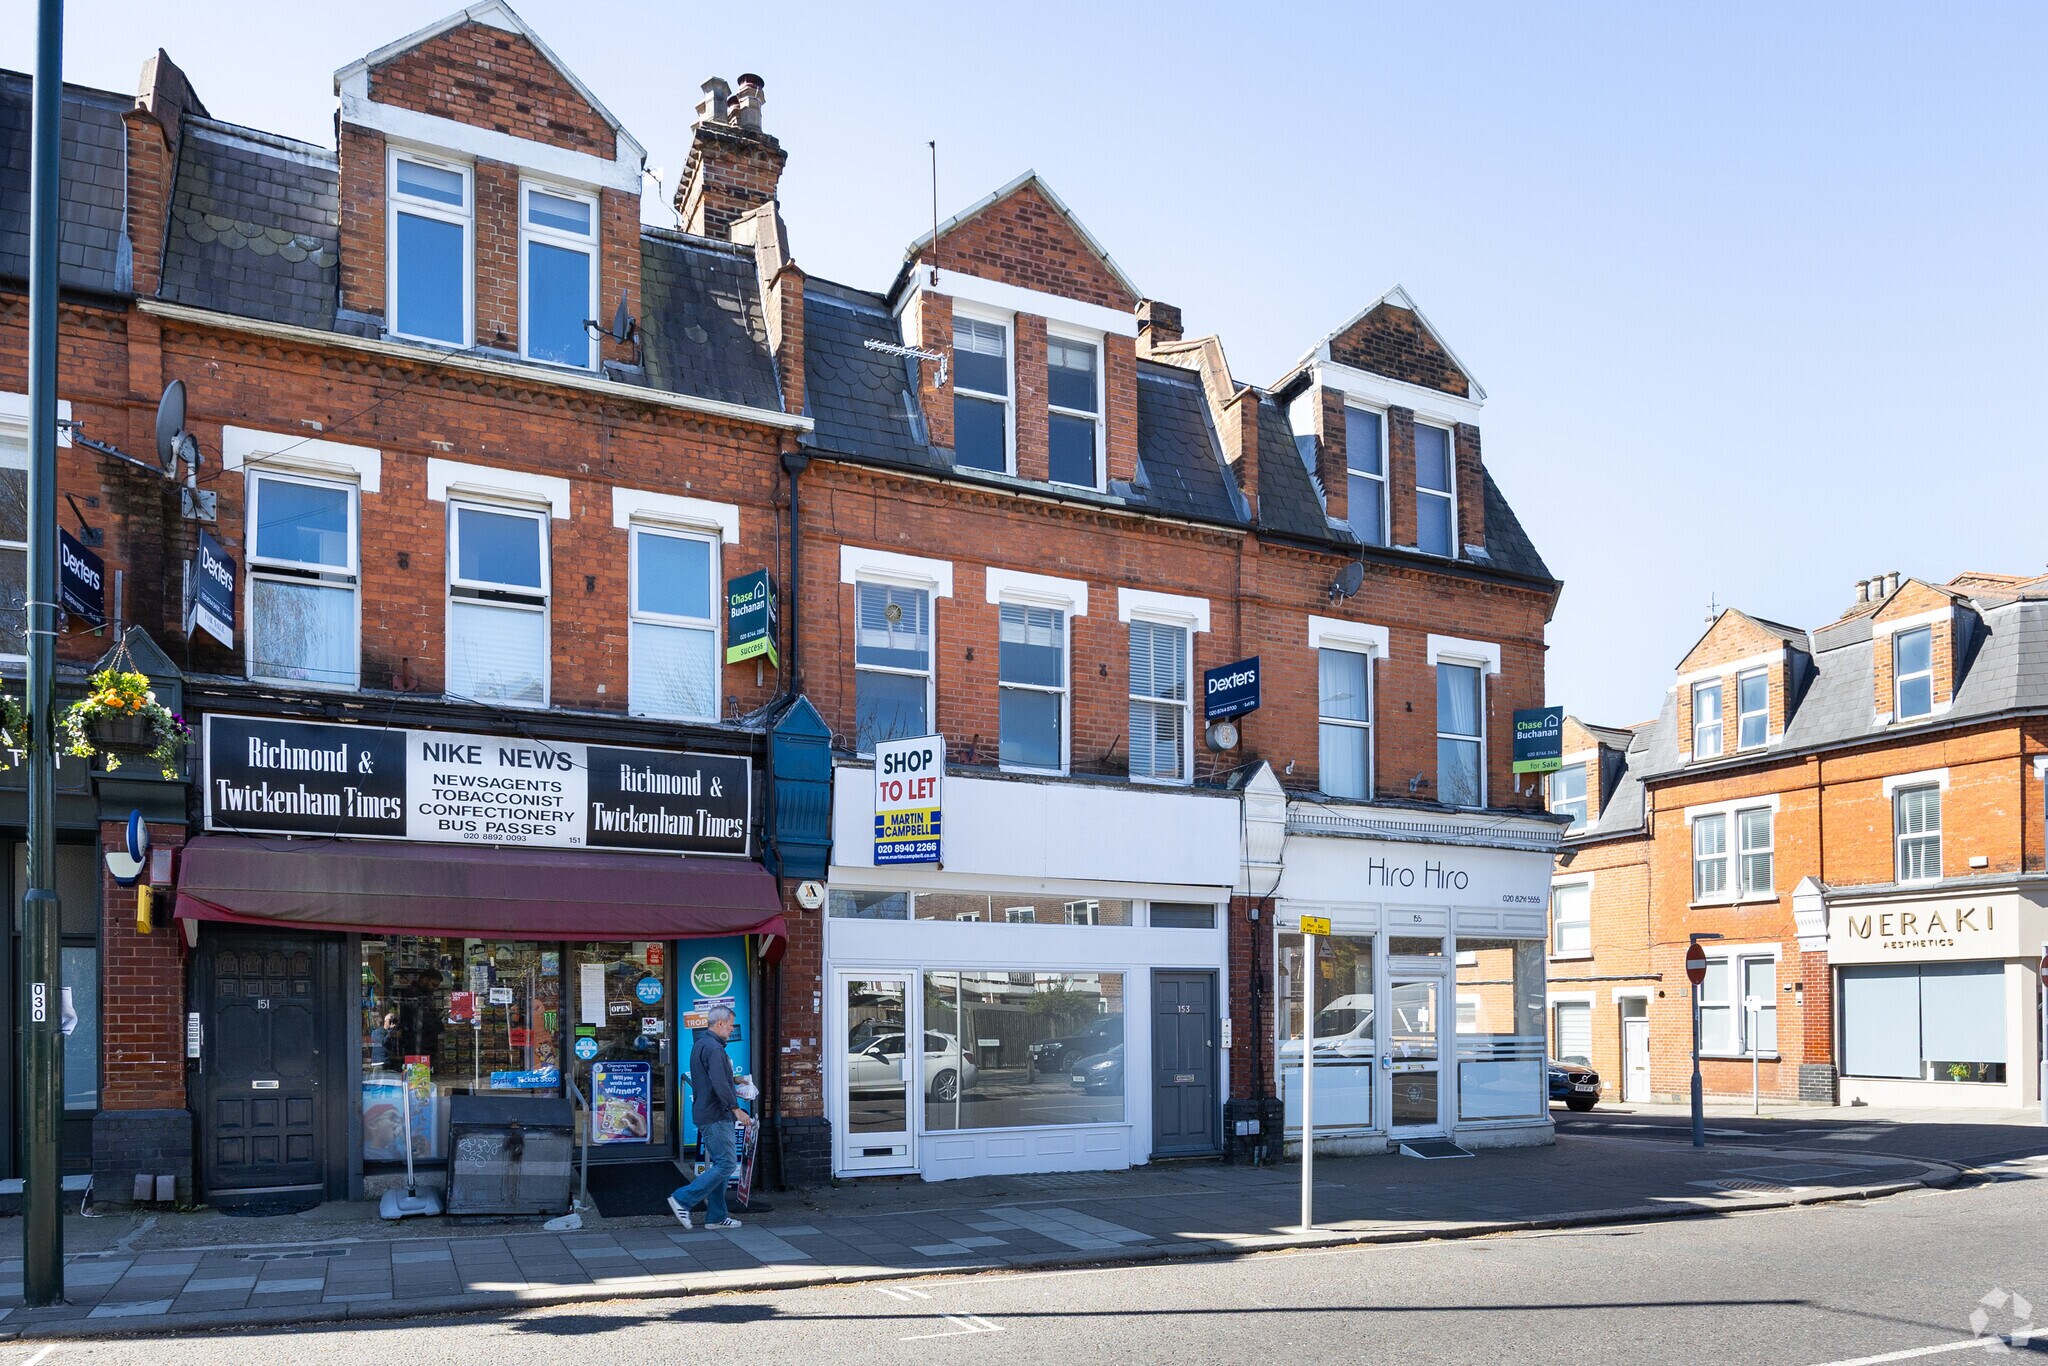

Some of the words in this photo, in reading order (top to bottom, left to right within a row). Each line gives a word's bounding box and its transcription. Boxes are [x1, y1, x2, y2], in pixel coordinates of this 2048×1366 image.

[62, 543, 100, 591] Dexters
[202, 546, 233, 592] Dexters
[732, 592, 752, 606] Chase
[731, 600, 764, 618] Buchanan
[740, 642, 763, 656] success
[1208, 670, 1255, 694] Dexters
[1517, 720, 1542, 730] Chase
[1517, 729, 1558, 740] Buchanan
[248, 736, 348, 773] Richmond
[358, 750, 374, 774] &
[422, 742, 482, 765] NIKE
[500, 747, 572, 771] NEWS
[884, 749, 932, 774] SHOP
[1531, 762, 1540, 770] for
[433, 774, 562, 793] NEWSAGENTS
[620, 764, 701, 796] Richmond
[710, 776, 722, 798] &
[880, 780, 902, 802] TO
[908, 777, 936, 800] LET
[216, 778, 341, 817] Twickenham
[343, 786, 400, 820] Times
[432, 788, 564, 807] TOBACCONIST
[418, 803, 575, 822] CONFECTIONERY
[592, 802, 693, 836] Twickenham
[696, 808, 743, 838] Times
[891, 812, 924, 826] MARTIN
[438, 819, 476, 832] BUS
[486, 822, 556, 836] PASSES
[885, 824, 930, 838] CAMPBELL
[464, 832, 480, 840] 020
[482, 833, 503, 841] 8892
[506, 834, 527, 842] 0093
[878, 844, 892, 854] 020
[894, 843, 915, 853] 8940
[917, 842, 937, 851] 2266
[1368, 856, 1414, 888] Hiro
[1425, 860, 1469, 890] Hiro
[1502, 894, 1514, 902] 020
[1848, 906, 1994, 939] MERAKI
[1884, 938, 1954, 949] AESTHETICS
[694, 972, 729, 982] VELO
[639, 987, 660, 995] ZYN
[258, 999, 270, 1009] 151
[605, 1086, 642, 1094] winner?
